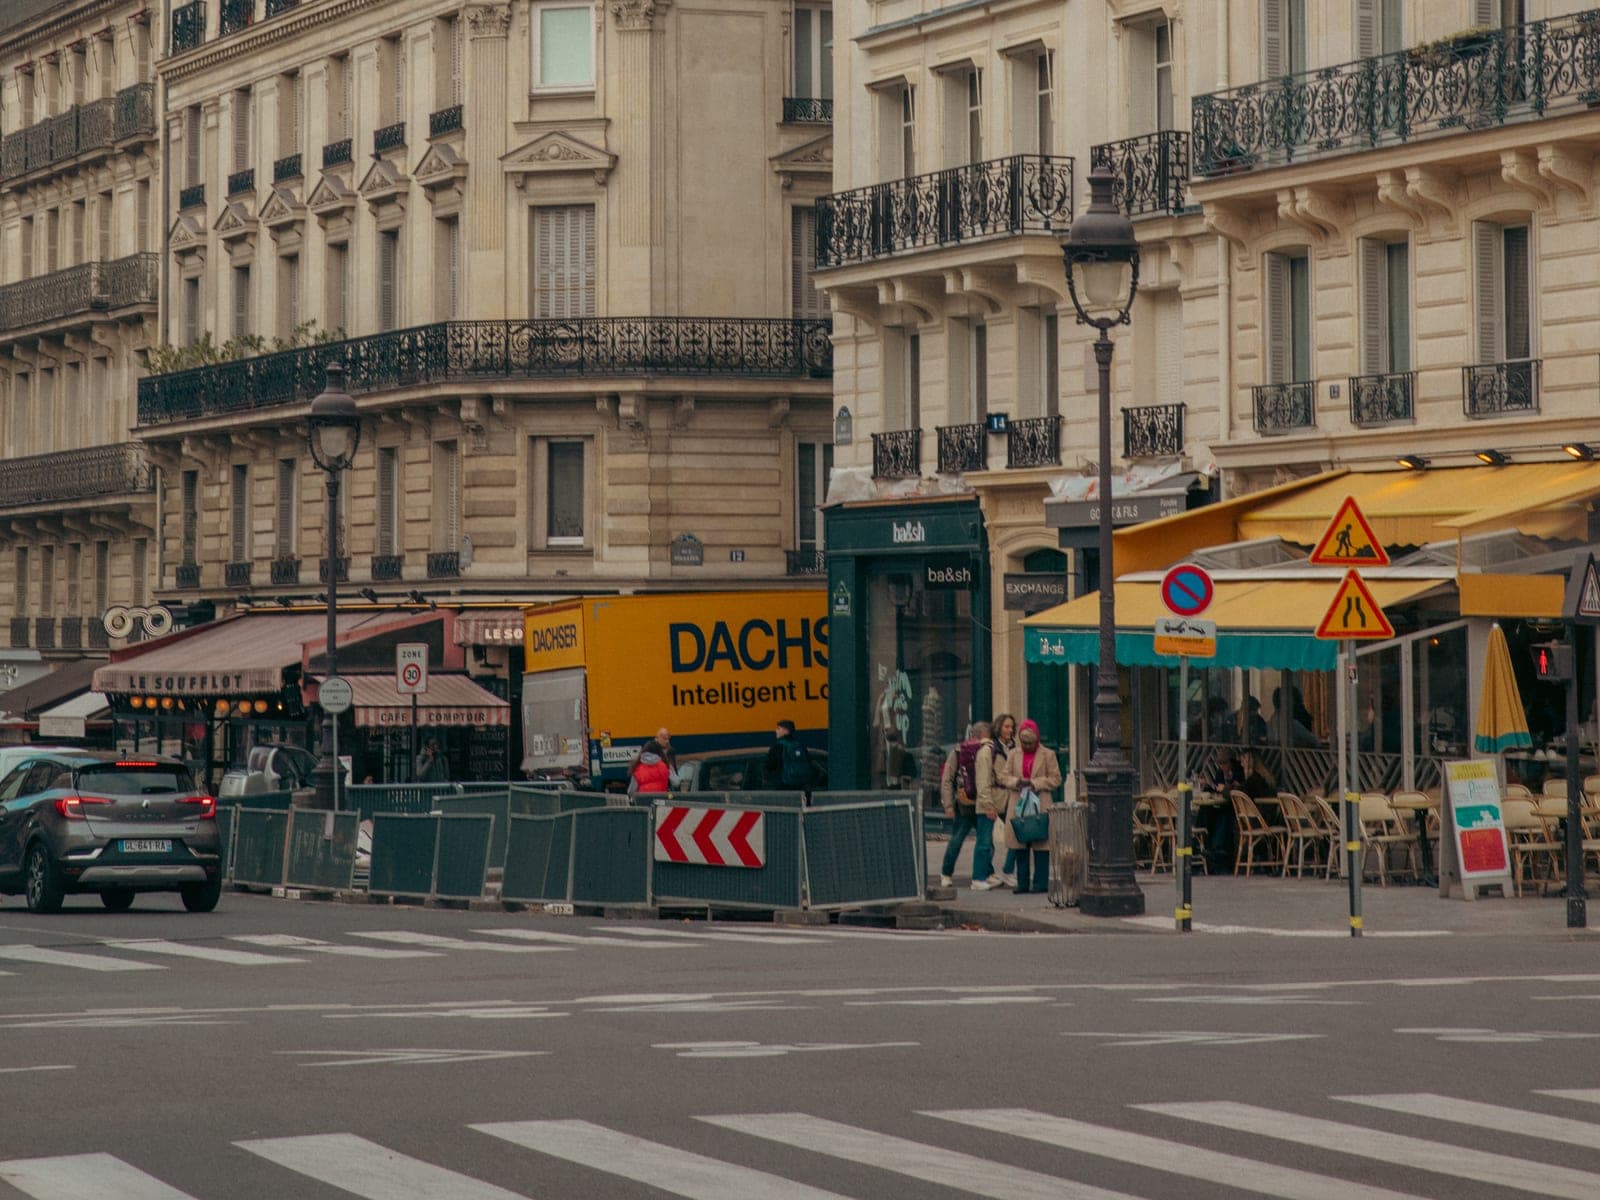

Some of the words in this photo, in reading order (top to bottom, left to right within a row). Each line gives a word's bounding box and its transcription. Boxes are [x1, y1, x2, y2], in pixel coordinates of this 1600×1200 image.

[992, 416, 1006, 429] 14
[1123, 505, 1138, 518] FILS
[892, 521, 925, 543] ba&sh
[927, 567, 971, 583] ba&sh
[1006, 583, 1065, 596] EXCHANGE
[485, 629, 501, 640] LE
[532, 624, 578, 653] DACHSER
[669, 616, 829, 673] DACHS
[407, 670, 418, 680] 30
[130, 676, 147, 689] LE
[155, 675, 242, 690] SOUFFLOT
[672, 680, 796, 709] Intelligent
[428, 712, 486, 722] COMPTOIR
